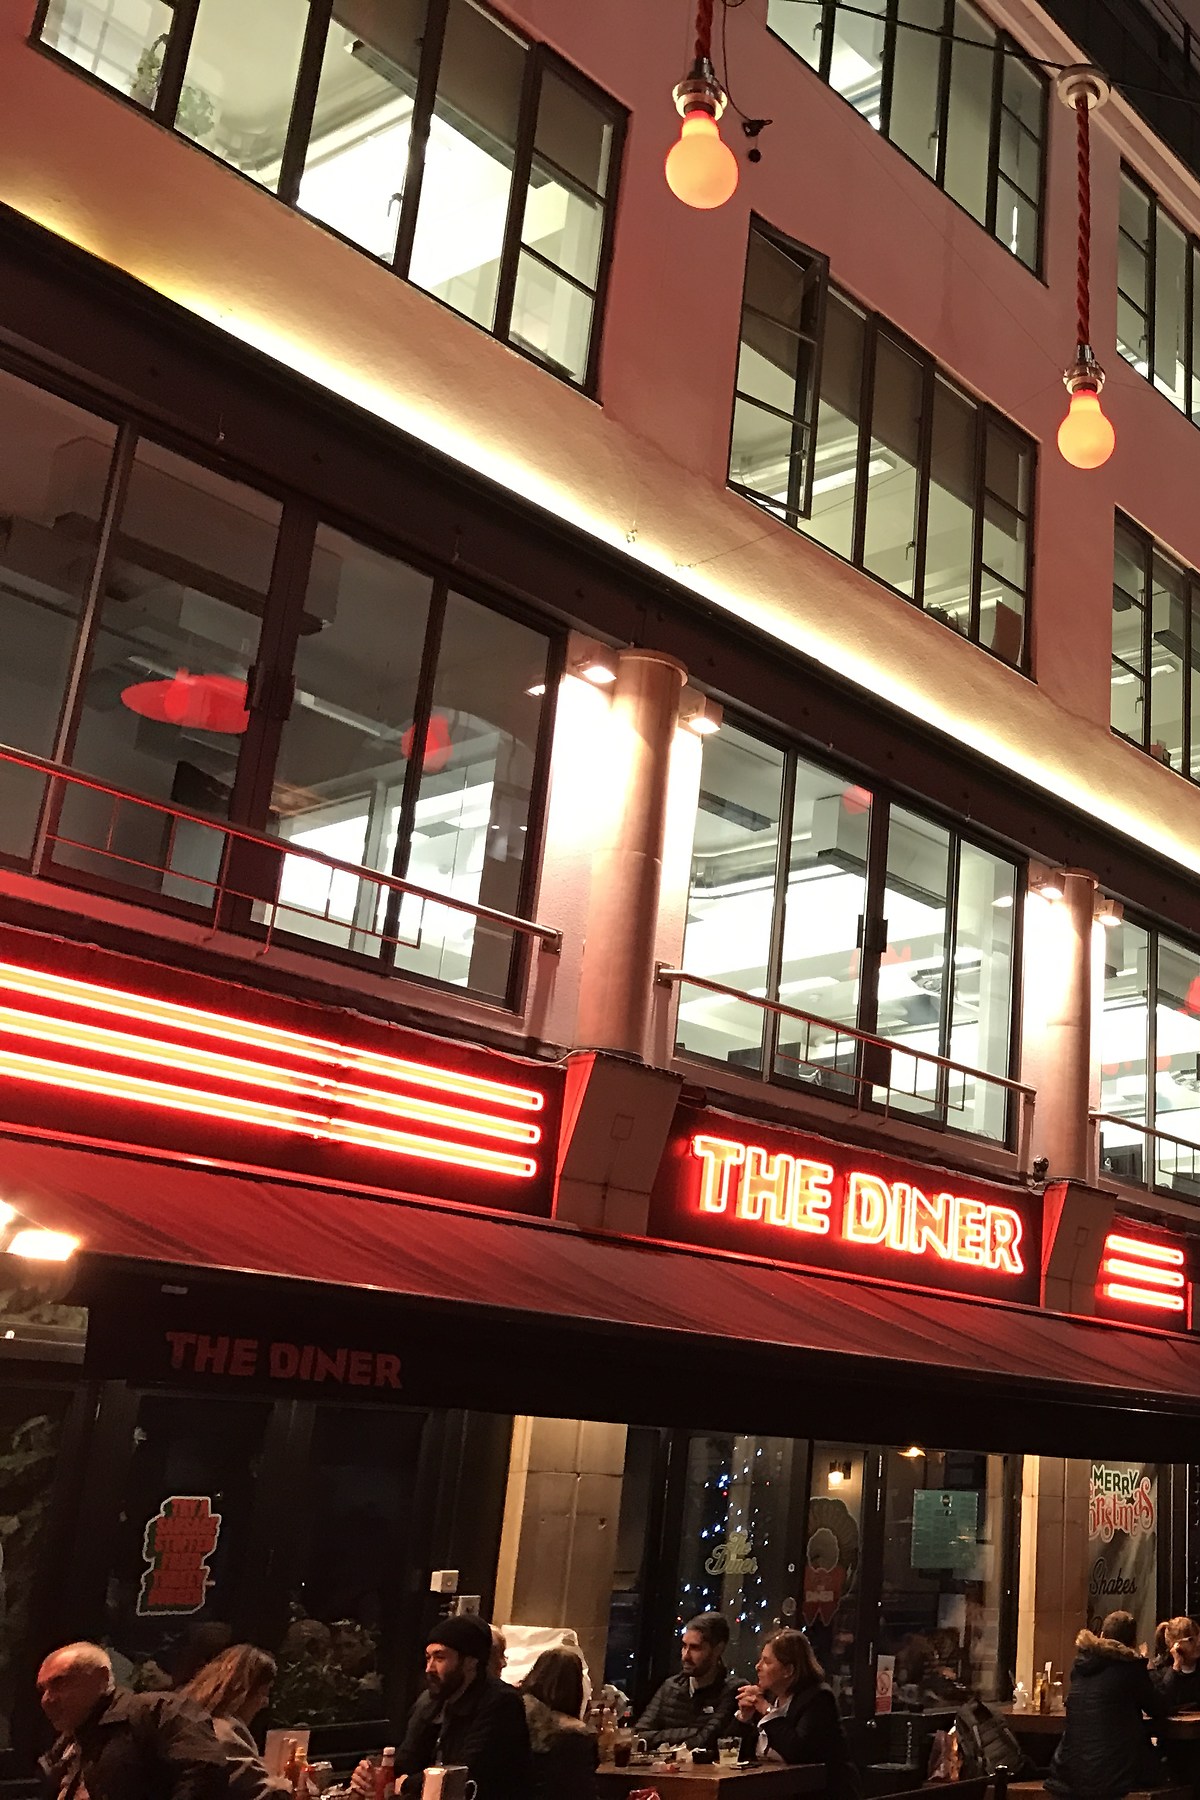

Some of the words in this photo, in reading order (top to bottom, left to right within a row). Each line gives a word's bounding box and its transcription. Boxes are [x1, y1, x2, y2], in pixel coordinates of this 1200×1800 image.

[693, 1134, 834, 1235] THE
[842, 1171, 1025, 1275] DINER
[165, 1331, 259, 1377] THE
[269, 1342, 403, 1389] DINER
[1093, 1467, 1139, 1496] MERRY
[1089, 1558, 1138, 1595] Shakes
